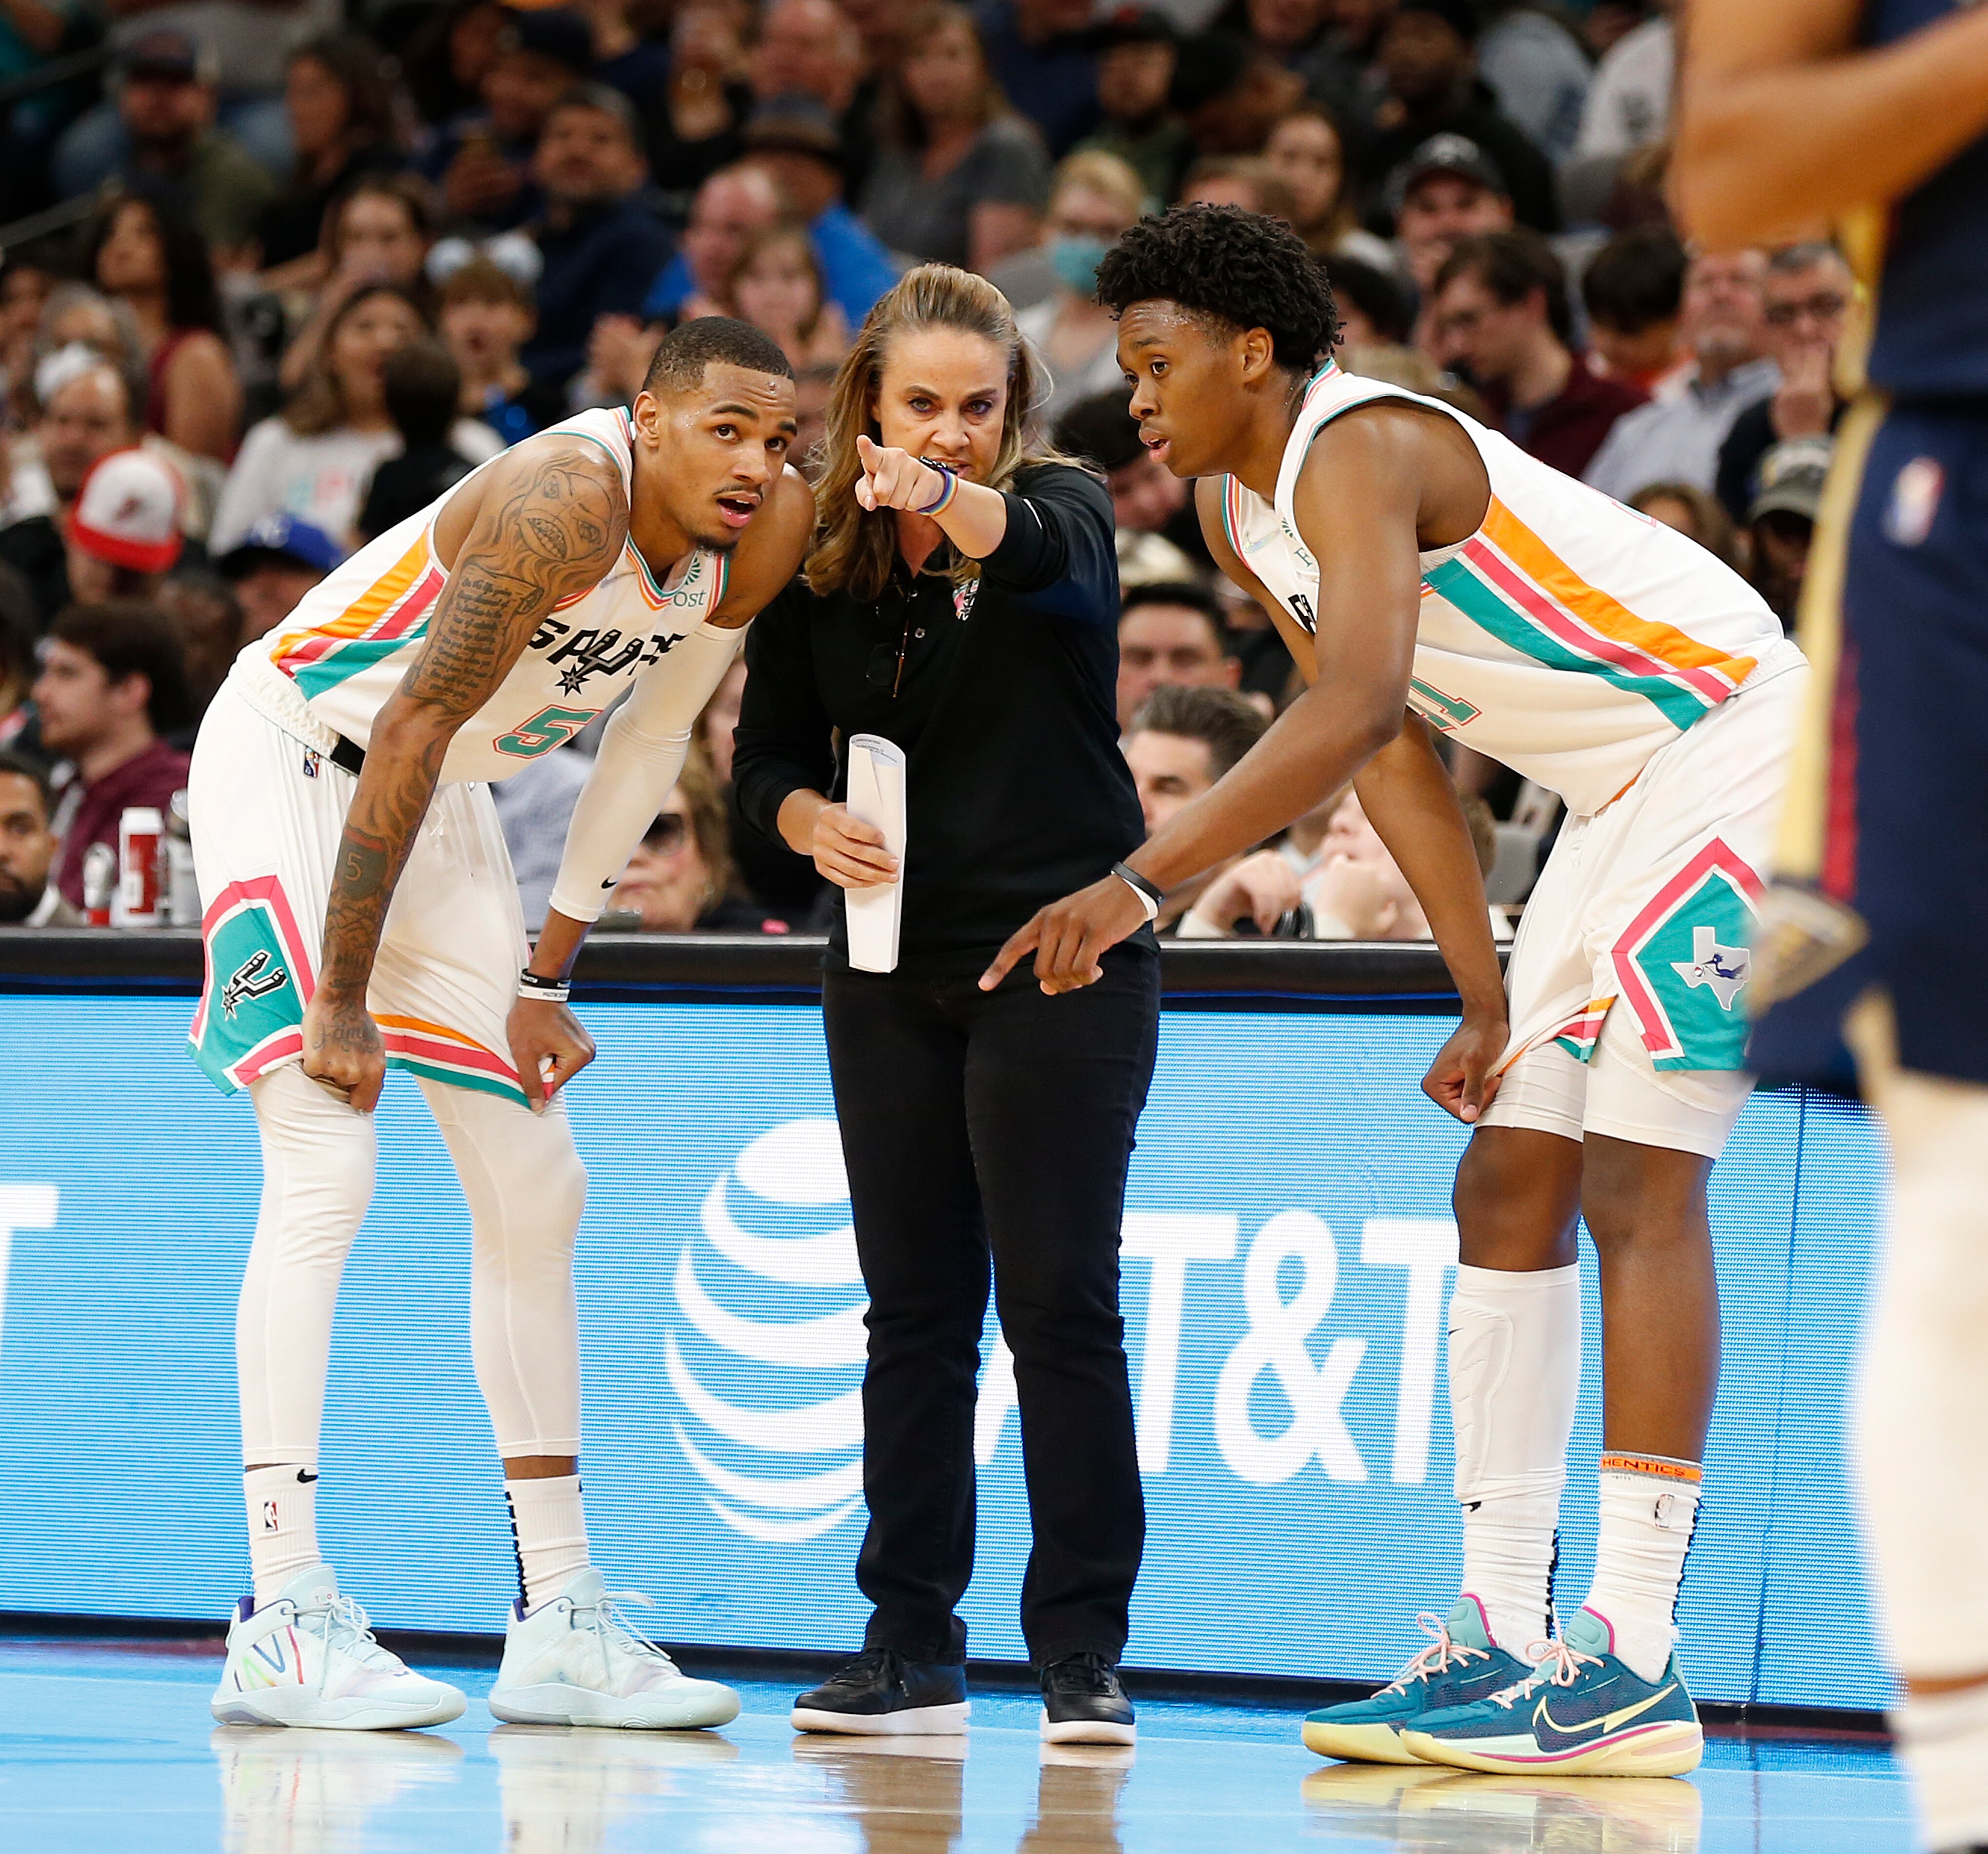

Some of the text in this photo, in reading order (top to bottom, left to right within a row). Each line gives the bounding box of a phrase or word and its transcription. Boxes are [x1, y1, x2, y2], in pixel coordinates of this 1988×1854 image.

[668, 589, 706, 606] ost
[492, 704, 604, 759] 5
[345, 852, 363, 882] 5
[973, 1210, 1460, 1483] T&T
